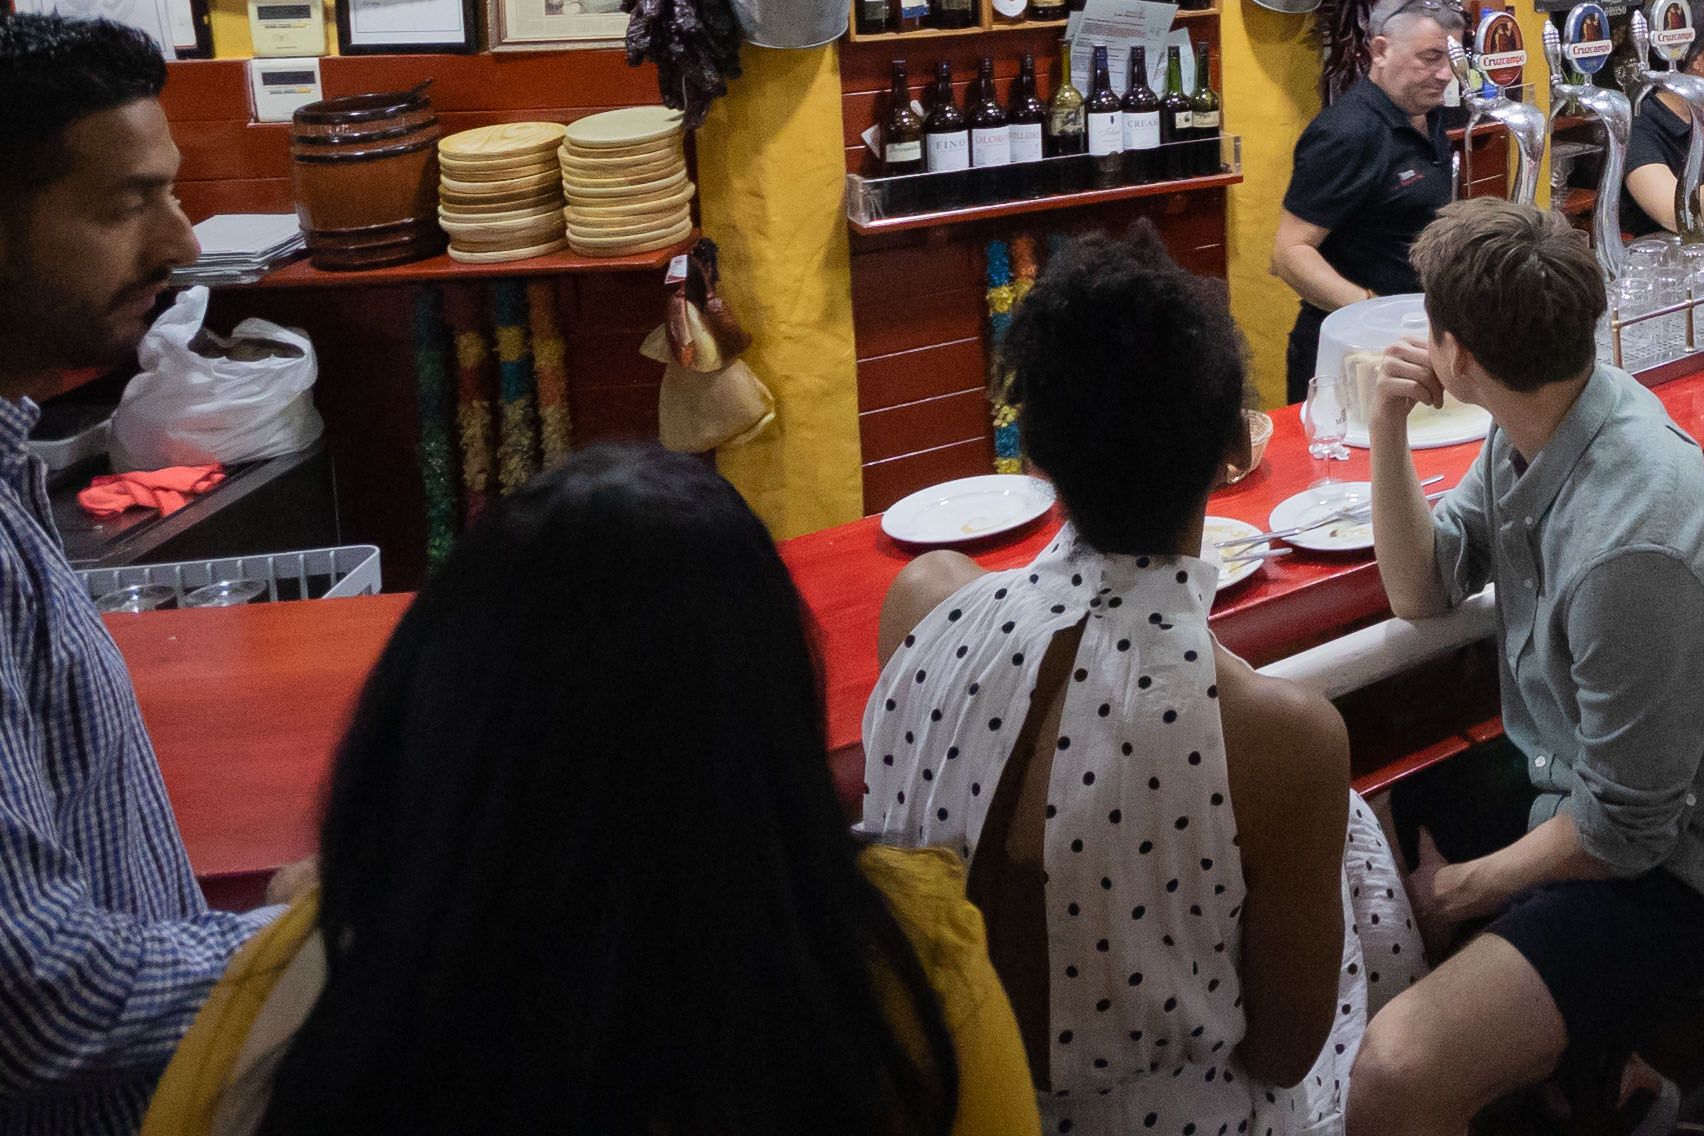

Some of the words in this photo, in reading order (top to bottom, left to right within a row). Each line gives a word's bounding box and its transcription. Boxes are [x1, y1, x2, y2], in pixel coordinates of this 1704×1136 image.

[1657, 32, 1695, 43] Cruzcampo
[1572, 44, 1610, 55] Cruzcampo
[1483, 55, 1525, 67] Cruzcampo
